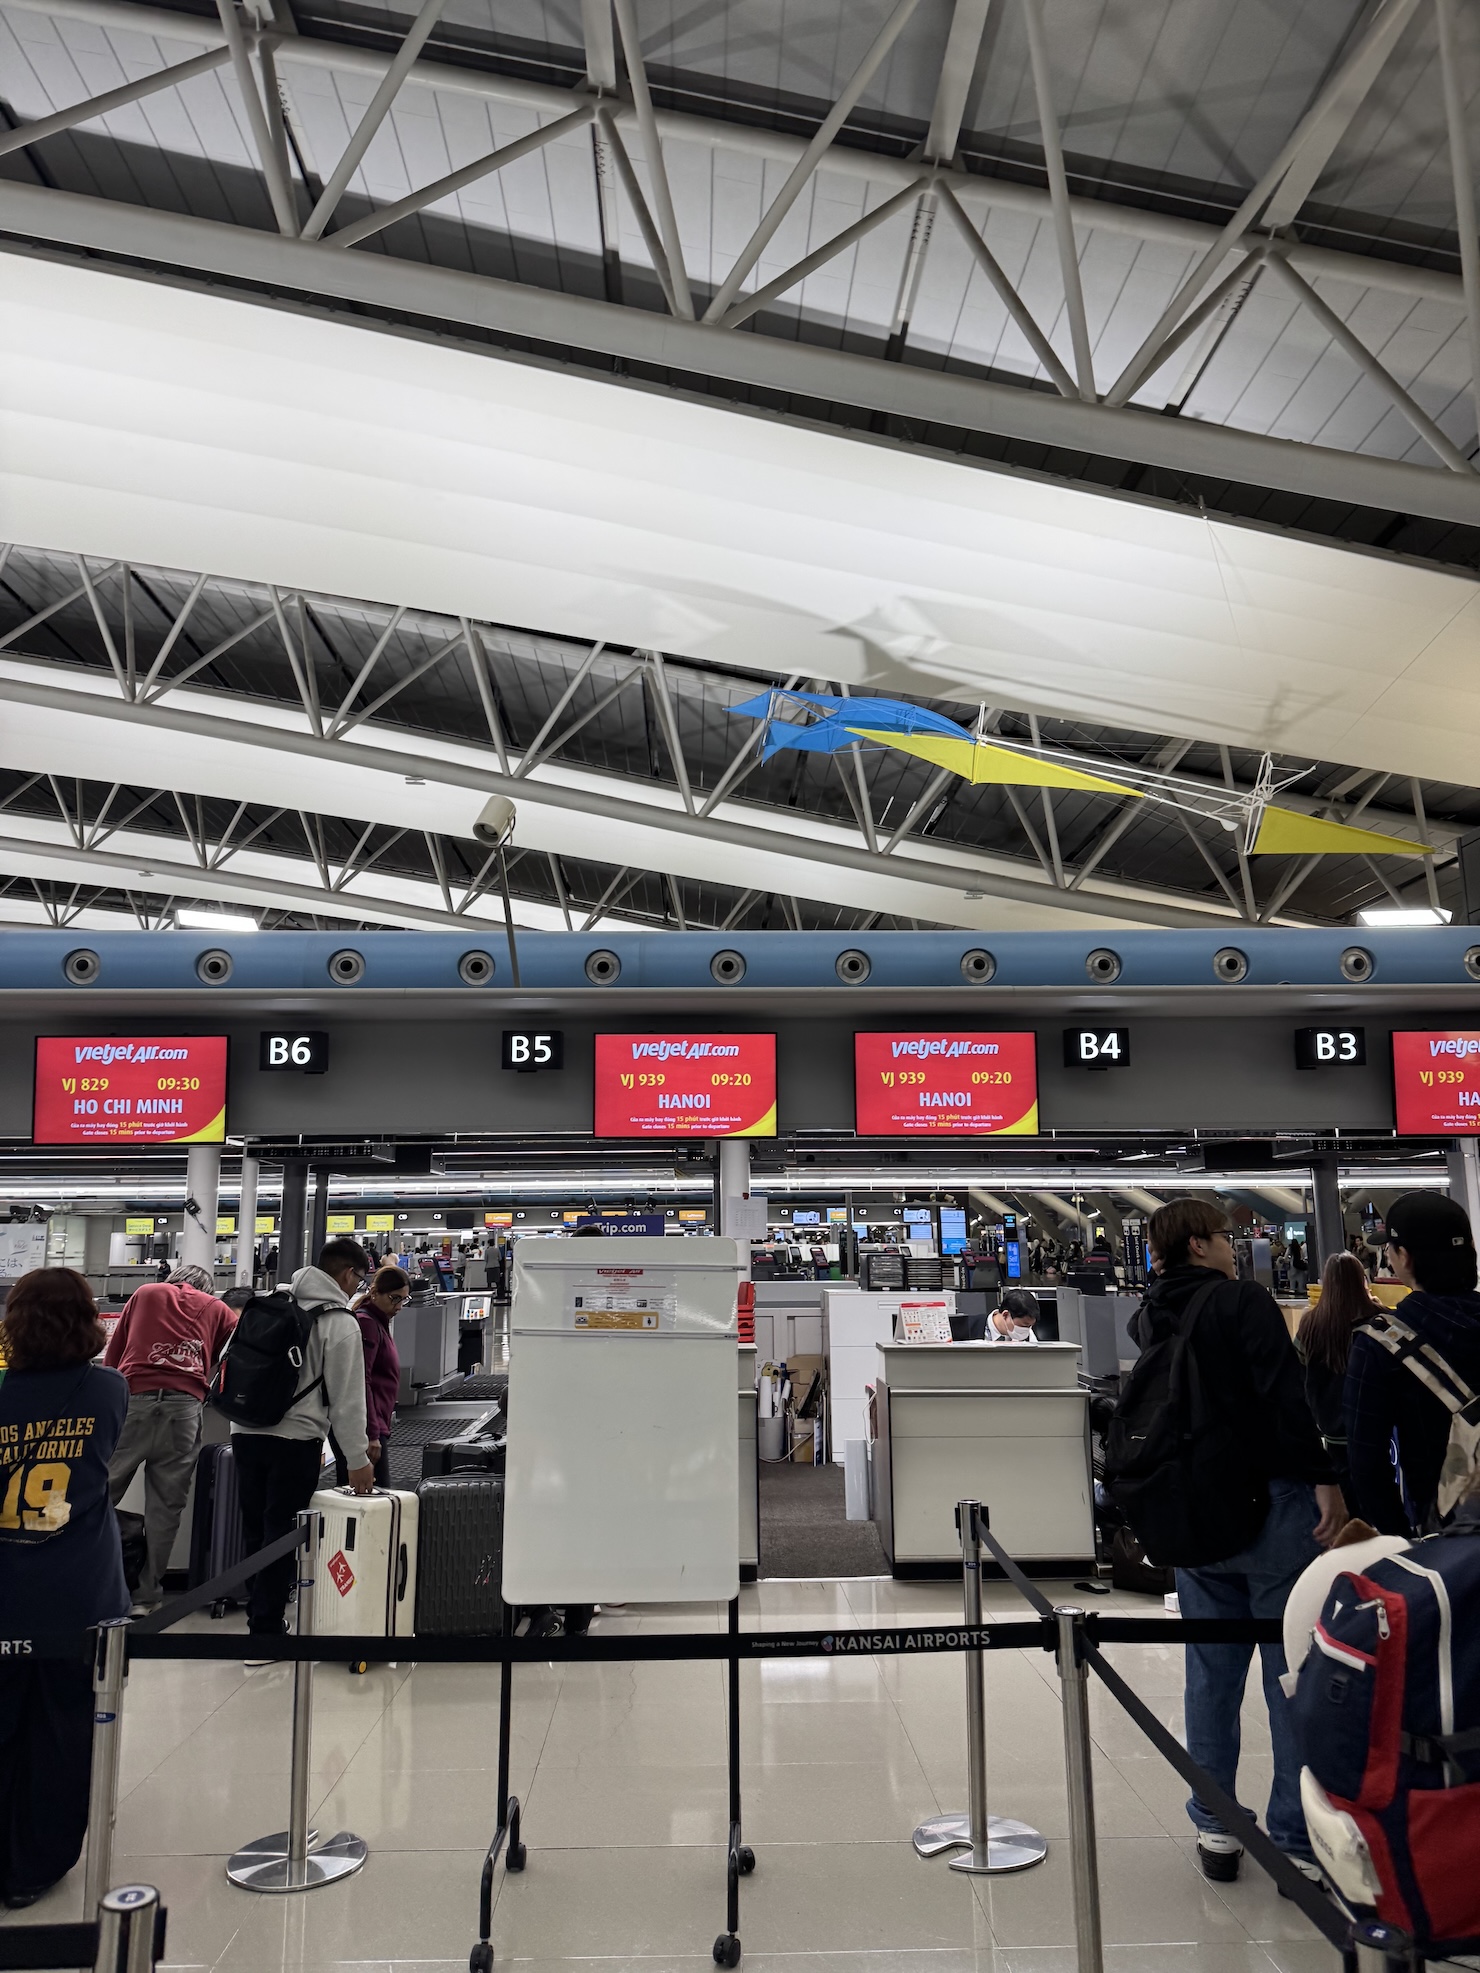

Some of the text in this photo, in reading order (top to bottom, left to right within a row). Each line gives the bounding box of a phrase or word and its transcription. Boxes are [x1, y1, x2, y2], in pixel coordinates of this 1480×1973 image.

[269, 1036, 312, 1065] B6
[511, 1035, 552, 1063] B5
[1079, 1032, 1122, 1060] B4
[1316, 1032, 1357, 1060] B3
[62, 1077, 200, 1095] VJ 829 09:30
[620, 1073, 751, 1089] VJ 939 09:20
[881, 1071, 1012, 1088] VJ 939 09:20
[1419, 1071, 1465, 1087] VJ 939
[73, 1098, 183, 1115] HO CHI MINH
[658, 1094, 711, 1109] HANOI
[920, 1092, 972, 1107] HANOI
[595, 1222, 647, 1235] Trip.com
[0, 1462, 72, 1531] 19
[0, 1640, 32, 1655] RTS
[751, 1641, 775, 1649] Shaping
[835, 1634, 900, 1652] KANSAI
[905, 1631, 990, 1650] AIRPORTS
